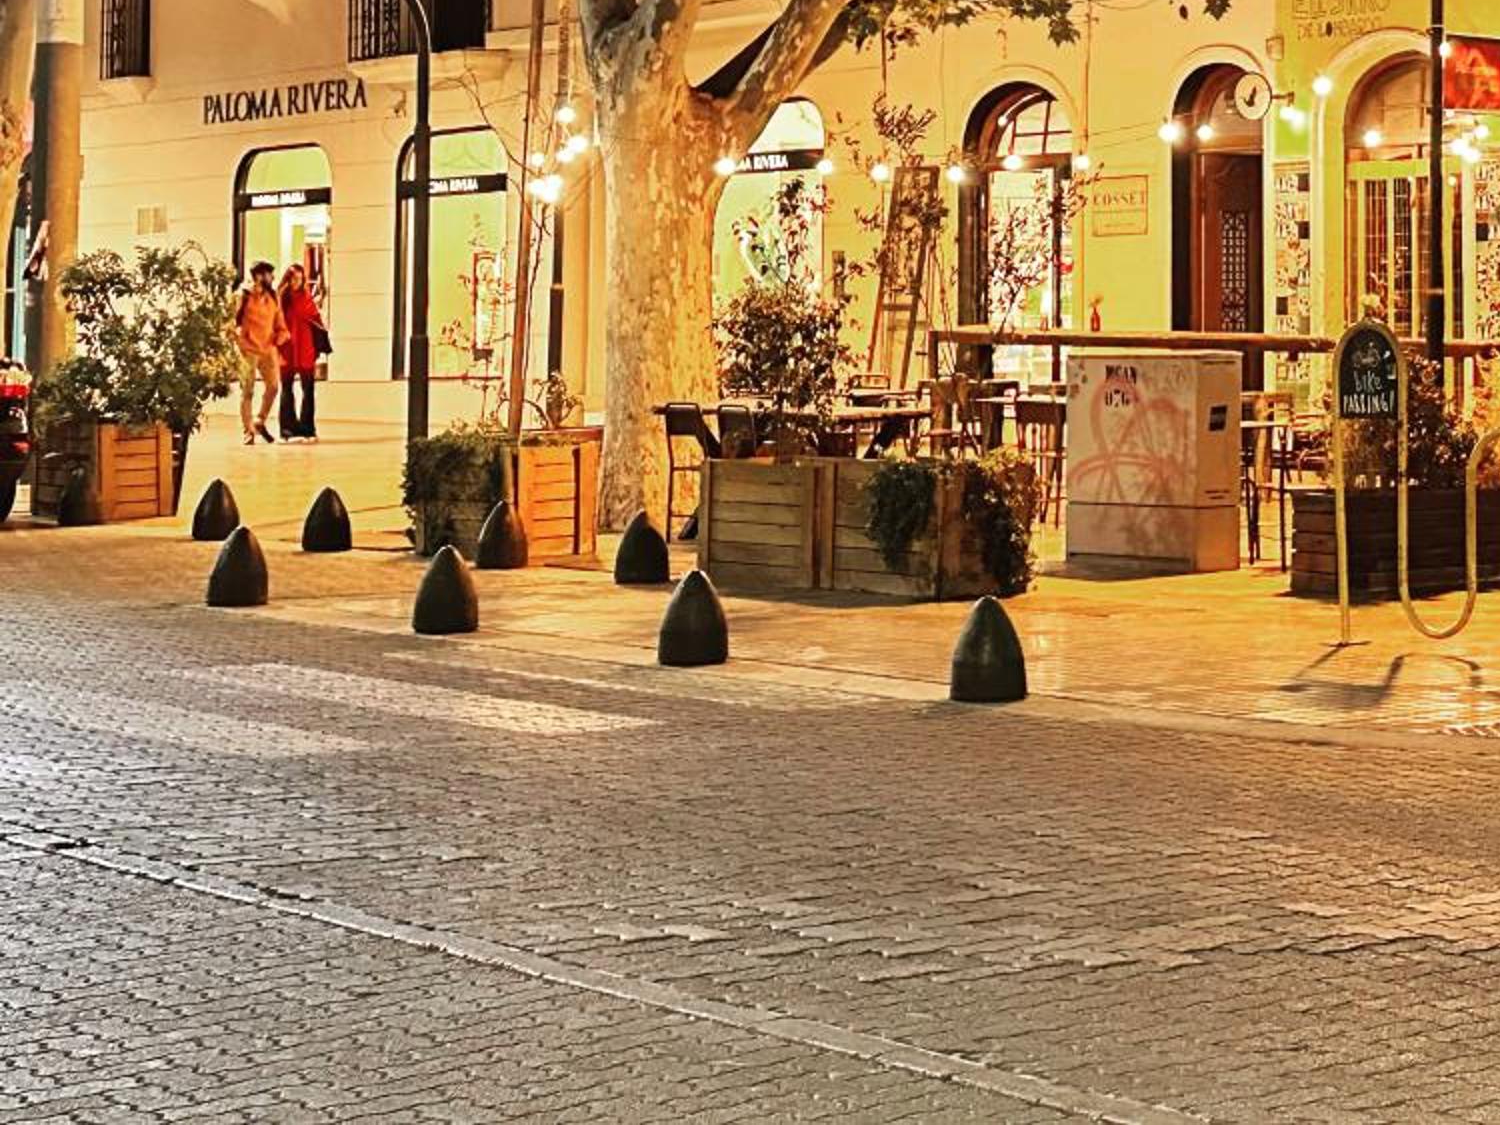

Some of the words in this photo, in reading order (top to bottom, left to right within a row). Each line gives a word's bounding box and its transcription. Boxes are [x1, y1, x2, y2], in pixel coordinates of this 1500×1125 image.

[203, 87, 283, 125] PALOMA
[287, 77, 368, 116] RIVERA
[1353, 369, 1382, 392] bike
